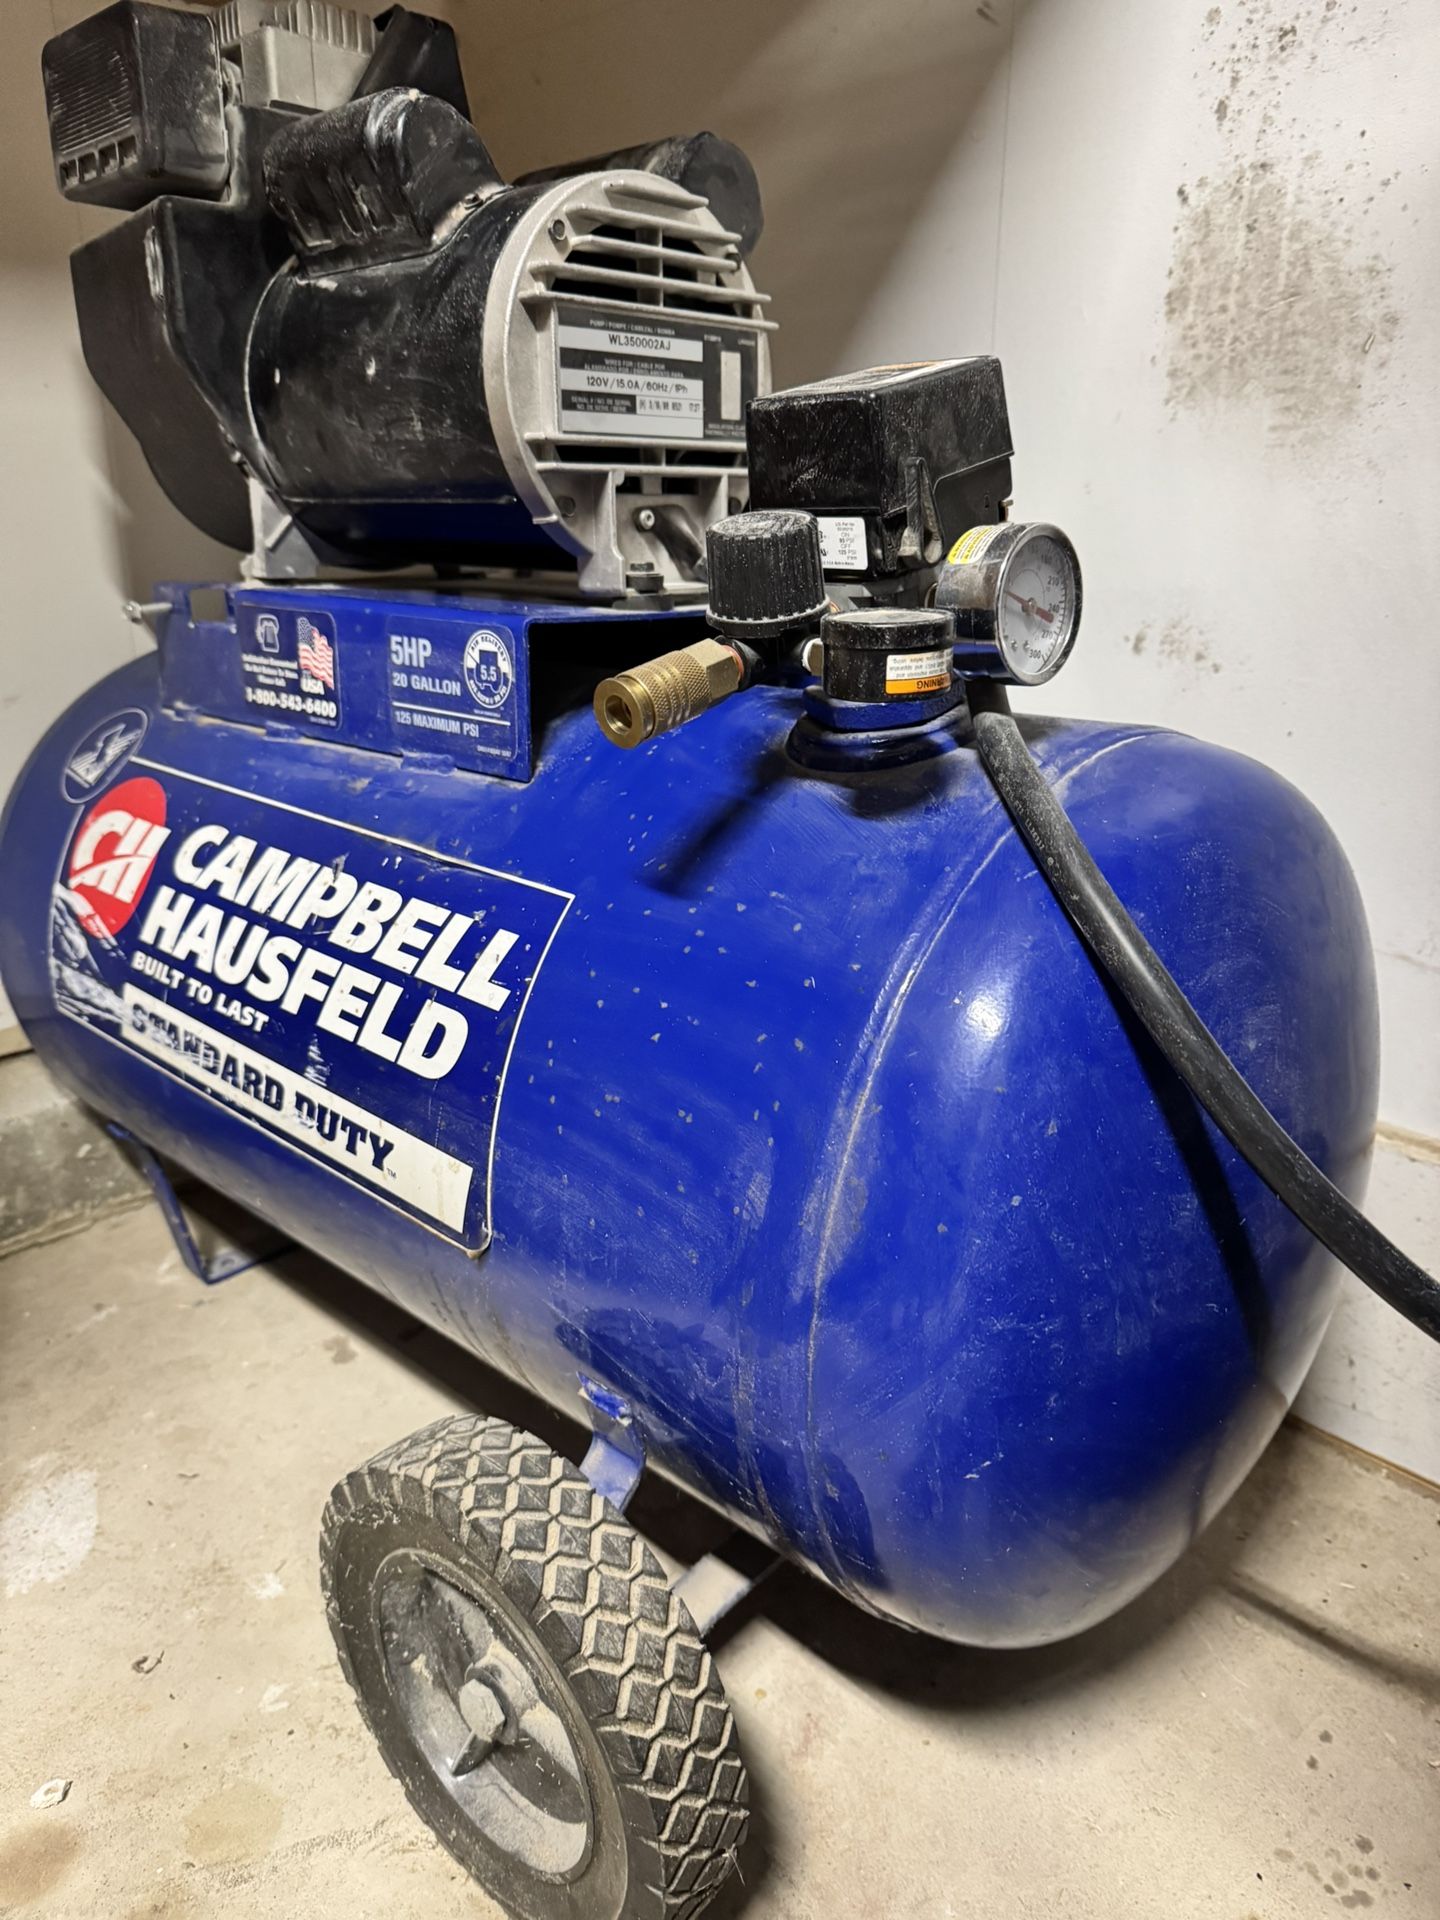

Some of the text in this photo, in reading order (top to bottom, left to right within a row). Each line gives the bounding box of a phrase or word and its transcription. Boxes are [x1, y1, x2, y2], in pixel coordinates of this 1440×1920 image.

[608, 333, 671, 351] WL350002AJ
[1048, 576, 1060, 587] 210
[390, 635, 432, 669] 5HP
[1029, 649, 1042, 659] 300
[392, 672, 408, 688] 20
[411, 674, 462, 696] GALLON
[480, 664, 497, 682] 5.5
[301, 679, 325, 695] USA
[246, 687, 337, 718] 1-800-543-6400
[395, 711, 411, 725] 125
[413, 713, 461, 734] MAXIMUM
[463, 722, 480, 738] PSI
[173, 824, 520, 1012] CAMPBELL
[130, 950, 270, 1033] BUILT TO LAST
[139, 885, 470, 1080] HAUSFELD
[294, 1090, 395, 1172] DUTY
